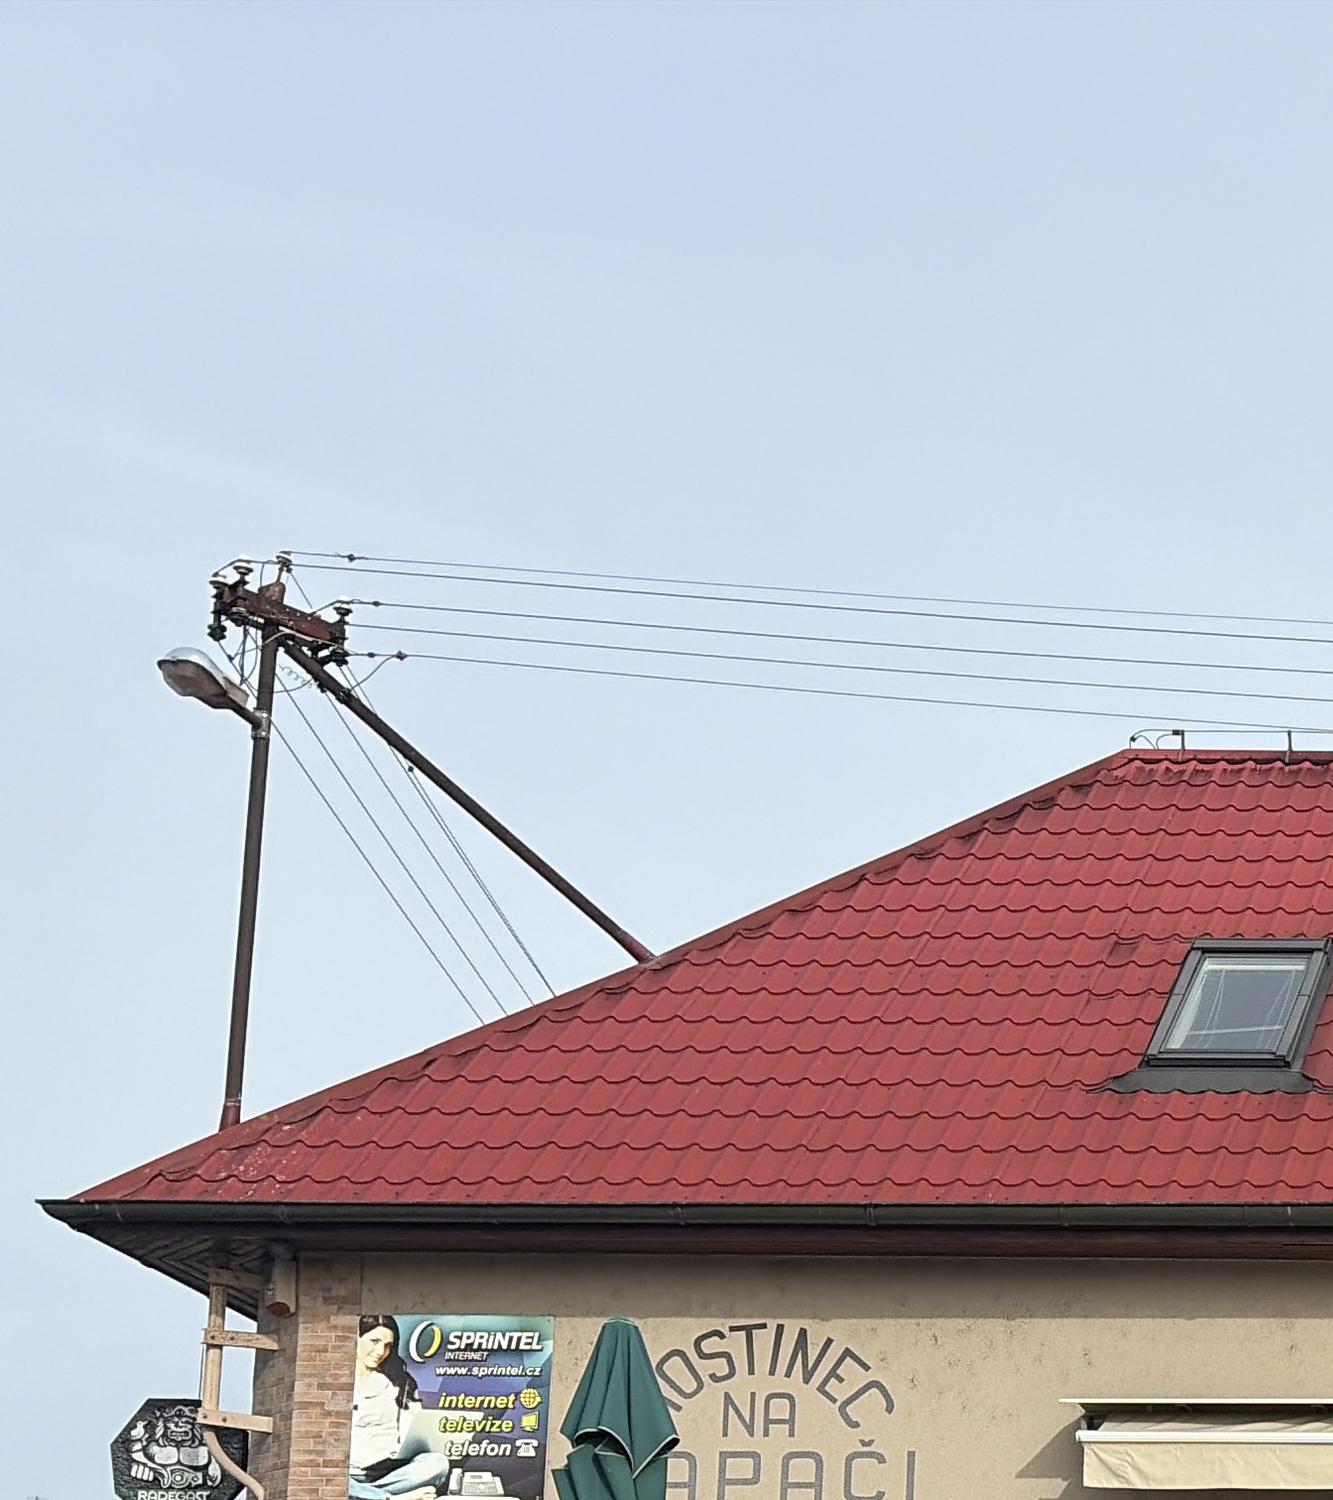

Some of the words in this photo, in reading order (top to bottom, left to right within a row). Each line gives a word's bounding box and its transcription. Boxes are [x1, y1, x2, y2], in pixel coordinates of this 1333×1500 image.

[444, 1351, 489, 1361] INTERNET
[435, 1365, 542, 1377] www.sprintel.cz
[655, 1322, 895, 1429] OSTINEC
[438, 1392, 517, 1409] internet
[721, 1391, 797, 1438] NA
[439, 1416, 513, 1433] televize
[444, 1439, 511, 1457] telefon
